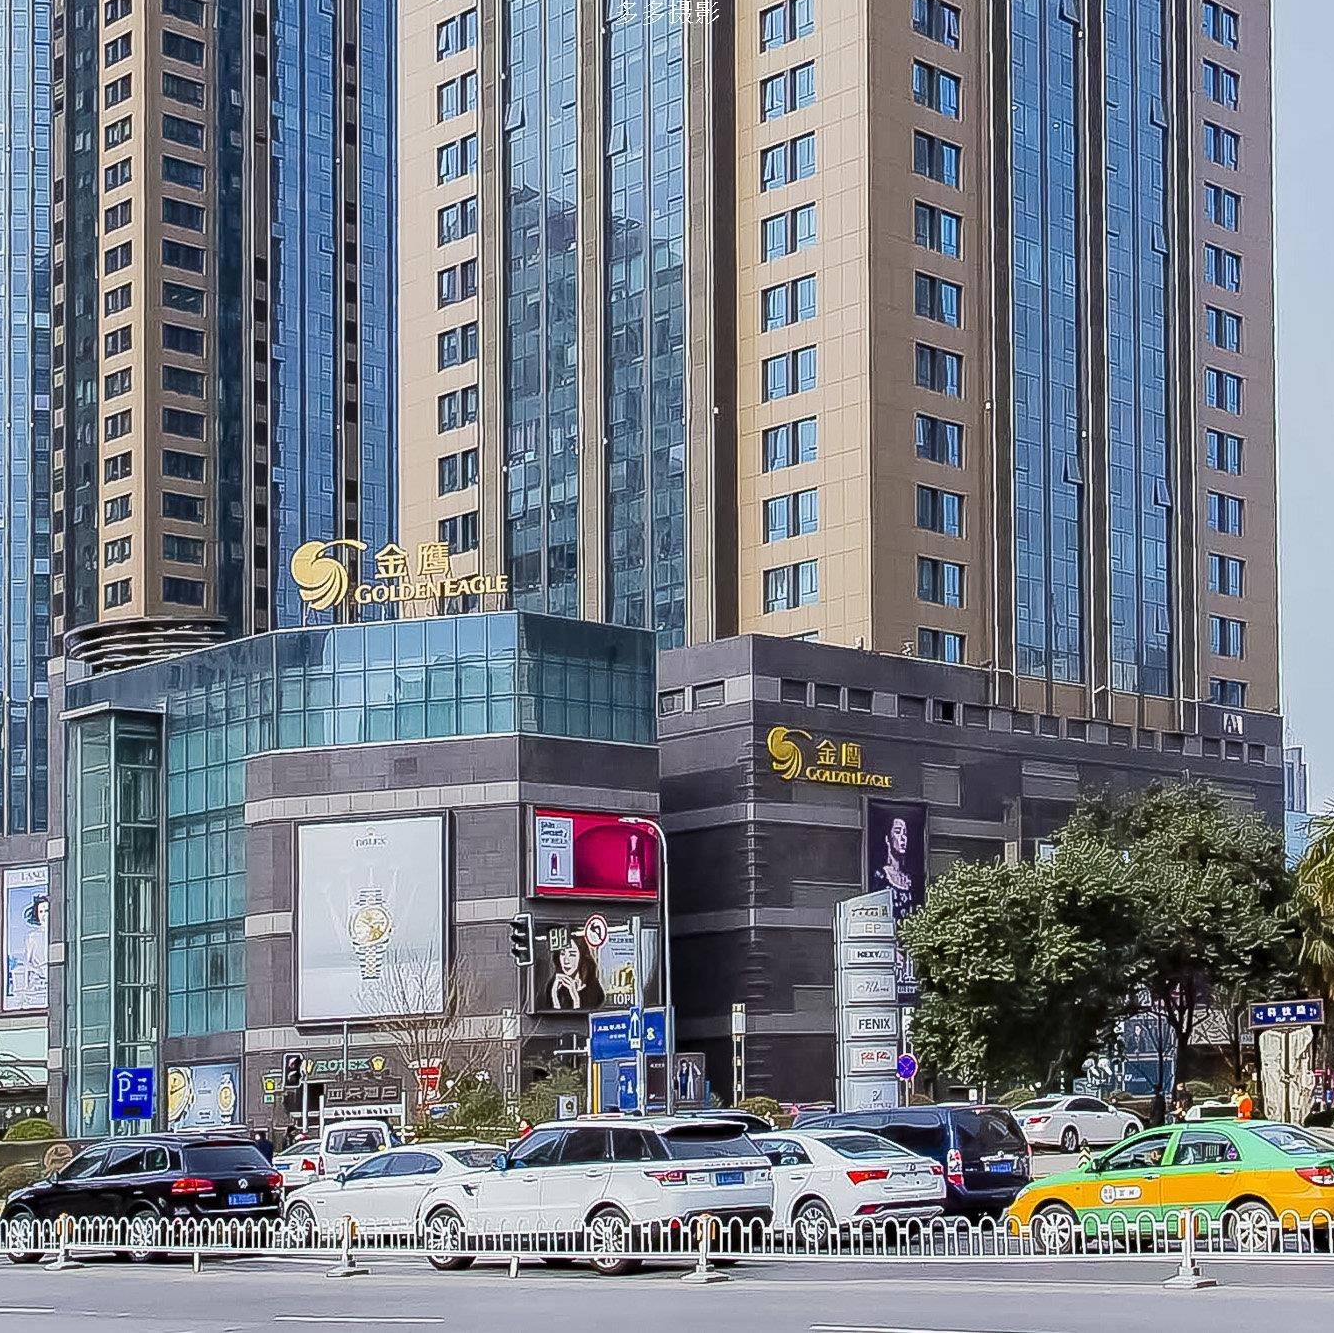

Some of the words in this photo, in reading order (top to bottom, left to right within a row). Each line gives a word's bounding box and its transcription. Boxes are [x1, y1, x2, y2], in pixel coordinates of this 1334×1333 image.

[374, 542, 451, 579] 金鹰
[858, 1018, 891, 1031] FENIX
[117, 1077, 131, 1103] P
